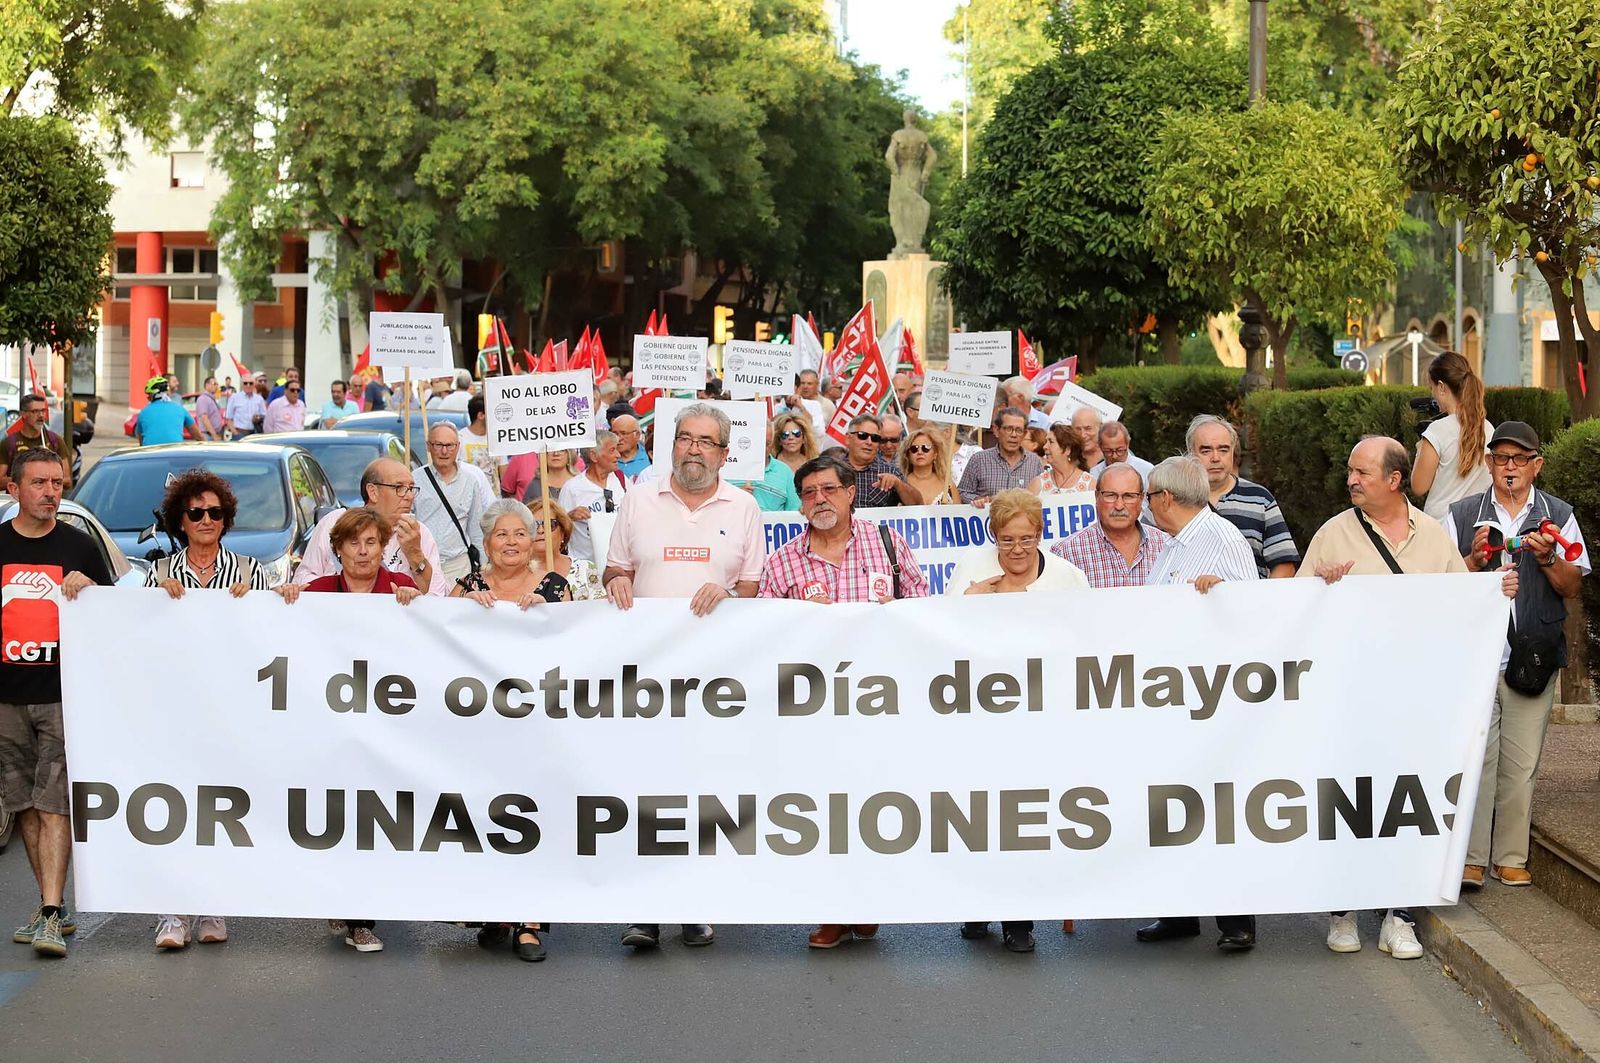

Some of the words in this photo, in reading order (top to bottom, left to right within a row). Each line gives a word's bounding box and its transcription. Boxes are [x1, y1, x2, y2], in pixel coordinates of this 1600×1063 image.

[643, 342, 676, 350] GOBIERNE
[732, 346, 767, 355] PENSIONES
[768, 349, 792, 357] DIGNAS
[653, 352, 686, 360] GOBIERNE
[651, 374, 687, 382] DEFIENDEN
[734, 373, 783, 387] MUJERES
[931, 376, 966, 387] PENSIONES
[967, 381, 992, 390] DIGNAS
[501, 388, 520, 399] NO
[524, 387, 540, 398] AL
[543, 383, 577, 396] ROBO
[526, 407, 538, 416] DE
[541, 406, 556, 415] LAS
[931, 403, 981, 418] MUJERES
[497, 422, 586, 443] PENSIONES
[588, 501, 602, 512] NO
[1058, 504, 1095, 538] LEP
[803, 583, 824, 599] UGT
[5, 640, 58, 662] CGT
[257, 656, 289, 711] 1
[325, 659, 417, 715] de
[444, 664, 747, 719] octubre
[777, 661, 900, 717] Día
[928, 658, 1043, 715] del
[1075, 654, 1313, 720] Mayor
[72, 781, 255, 848] POR
[287, 787, 541, 855] UNAS
[576, 786, 1112, 856] PENSIONES
